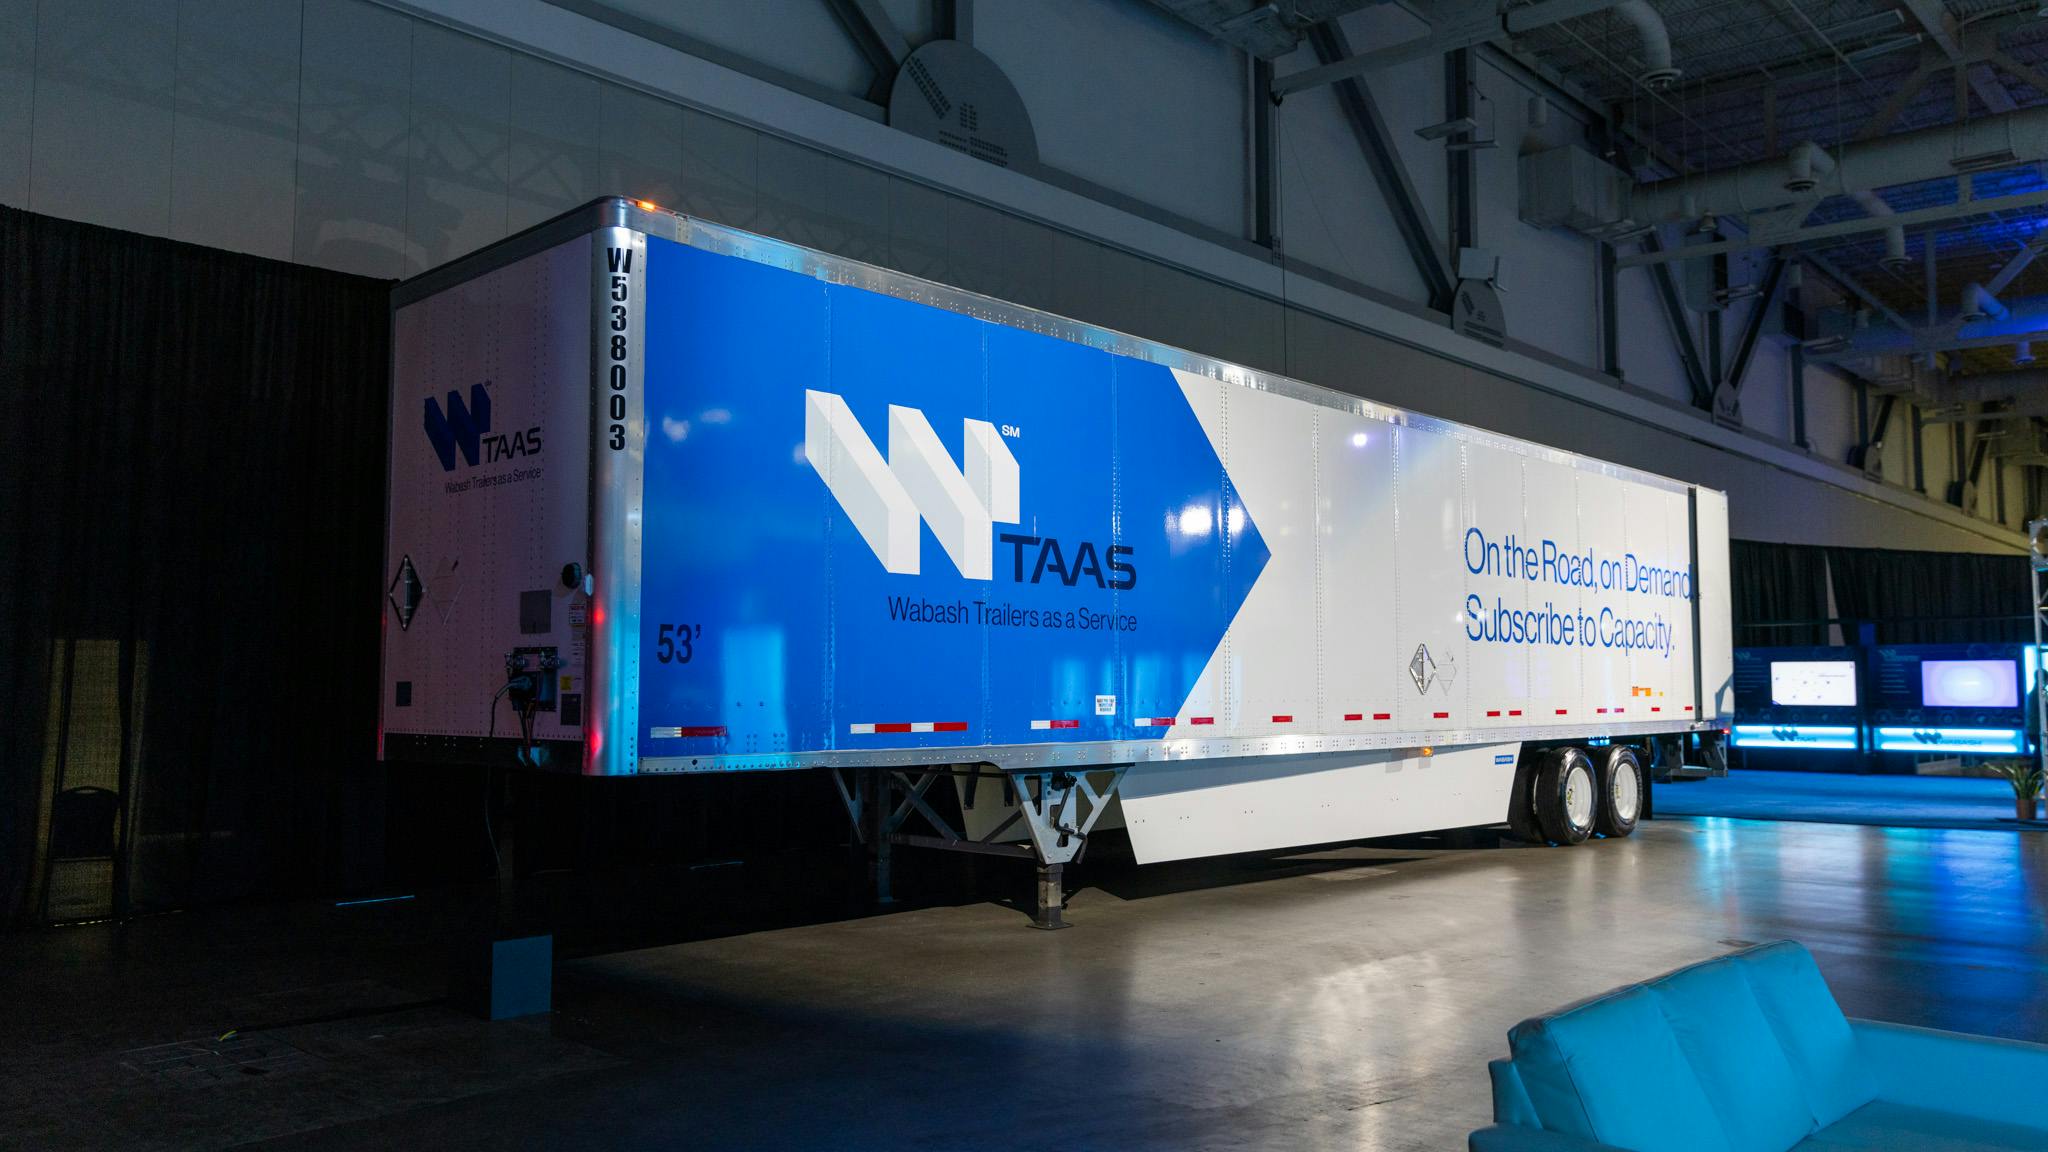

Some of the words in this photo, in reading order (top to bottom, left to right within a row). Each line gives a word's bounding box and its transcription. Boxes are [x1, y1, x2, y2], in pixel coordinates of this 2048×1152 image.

[606, 246, 633, 452] W538003
[481, 426, 542, 464] TAAS
[1001, 424, 1020, 438] SM
[444, 480, 472, 494] Wabash
[472, 474, 498, 489] Trailers
[497, 474, 507, 486] as
[513, 467, 542, 483] Service
[1000, 533, 1138, 591] TAAS
[1464, 527, 1500, 576] On
[1504, 534, 1539, 581] the
[1542, 539, 1598, 594] Road,
[1600, 559, 1622, 591] on
[1624, 553, 1694, 600] Demand
[888, 596, 969, 625] Wabash
[973, 601, 1039, 628] Trailers
[1042, 609, 1062, 628] as
[1065, 610, 1076, 629] a
[1078, 607, 1138, 632] Service
[1466, 593, 1575, 646] Subscribe
[1577, 607, 1597, 647] to
[1599, 606, 1676, 658] Capacity.
